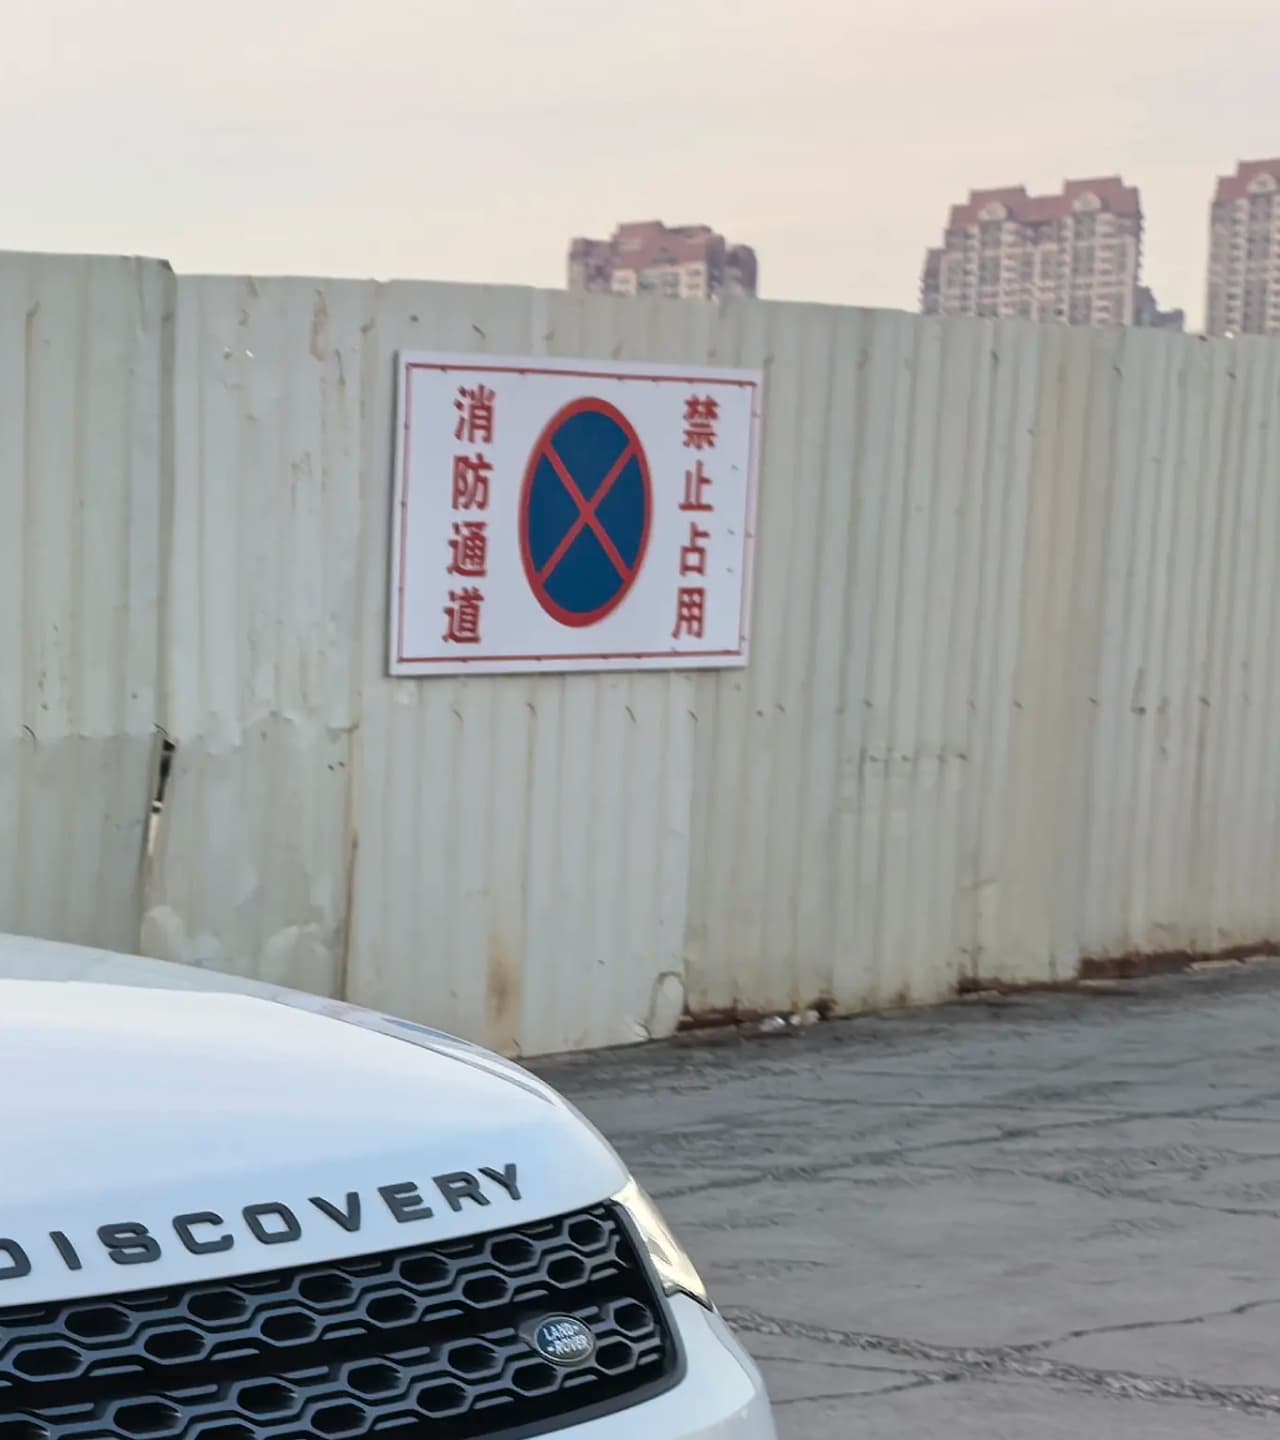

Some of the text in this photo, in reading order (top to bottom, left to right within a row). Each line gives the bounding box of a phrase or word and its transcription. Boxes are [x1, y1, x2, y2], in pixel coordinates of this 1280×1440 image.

[442, 384, 496, 644] 消防通道
[671, 394, 719, 639] 禁止占用
[543, 1322, 575, 1341] LAND
